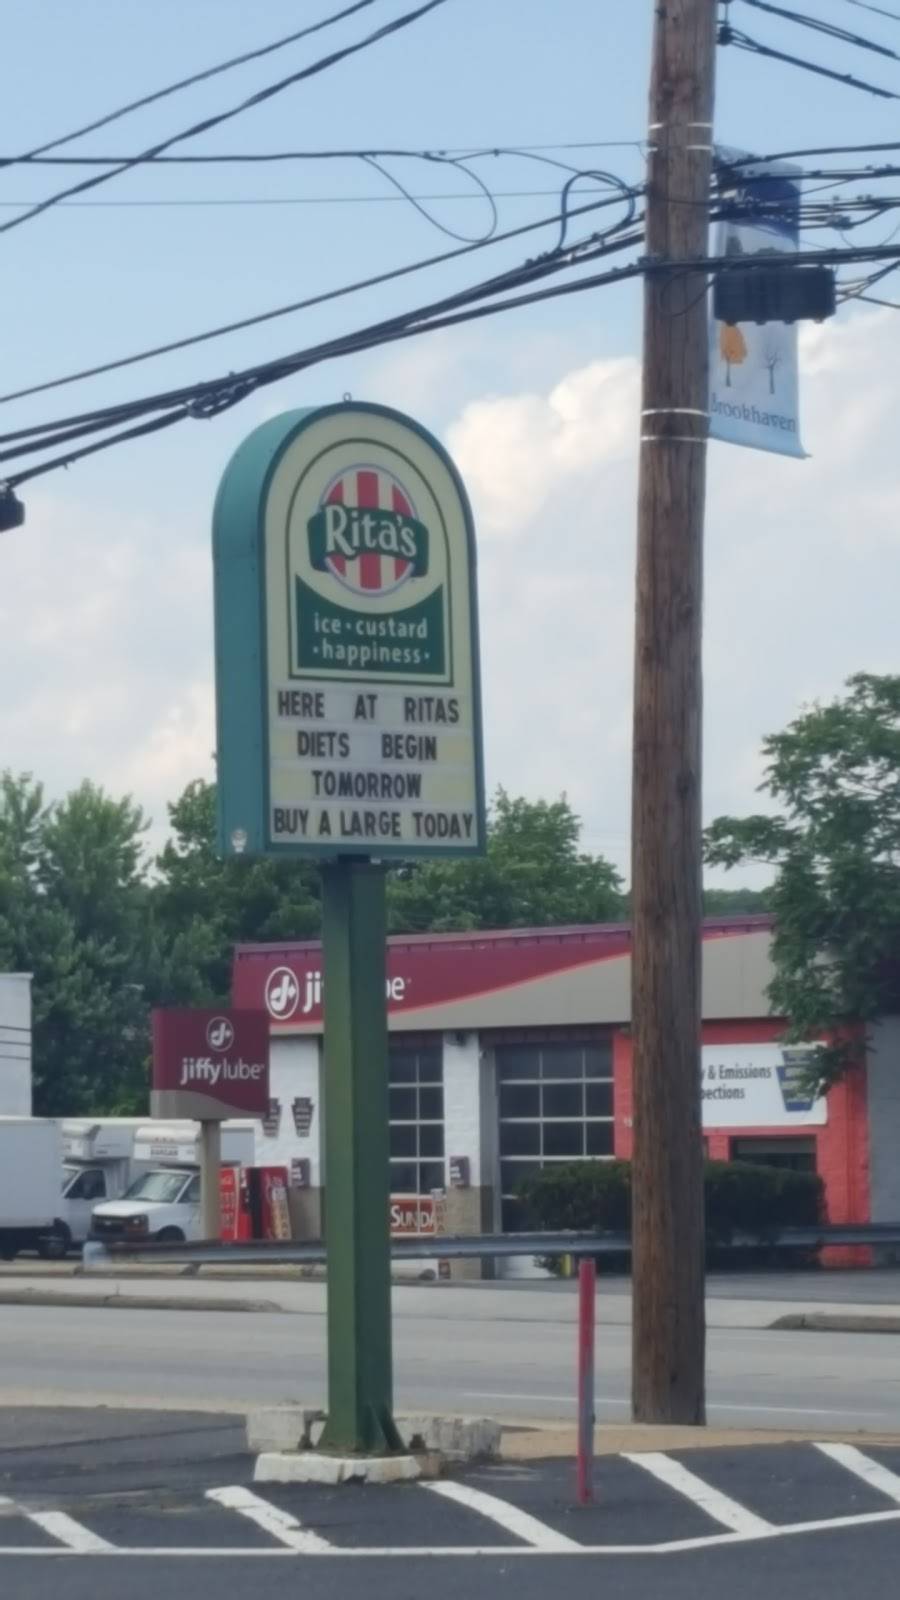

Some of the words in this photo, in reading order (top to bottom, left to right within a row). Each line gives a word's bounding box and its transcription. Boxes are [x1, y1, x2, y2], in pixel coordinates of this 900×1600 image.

[325, 505, 418, 558] Rita's
[314, 613, 342, 634] ice
[355, 615, 429, 639] custard
[322, 638, 423, 666] happiness
[278, 690, 326, 719] HERE
[354, 694, 378, 720] AT
[404, 697, 460, 724] RITAS
[297, 731, 350, 758] DIETS
[381, 734, 438, 761] BEGIN
[311, 769, 423, 799] TOMORROW
[273, 807, 310, 835] BUY
[318, 810, 332, 836] A
[340, 810, 402, 838] LARGE
[412, 812, 474, 839] TODAY
[708, 1064, 716, 1080] &
[719, 1062, 772, 1080] Emissions
